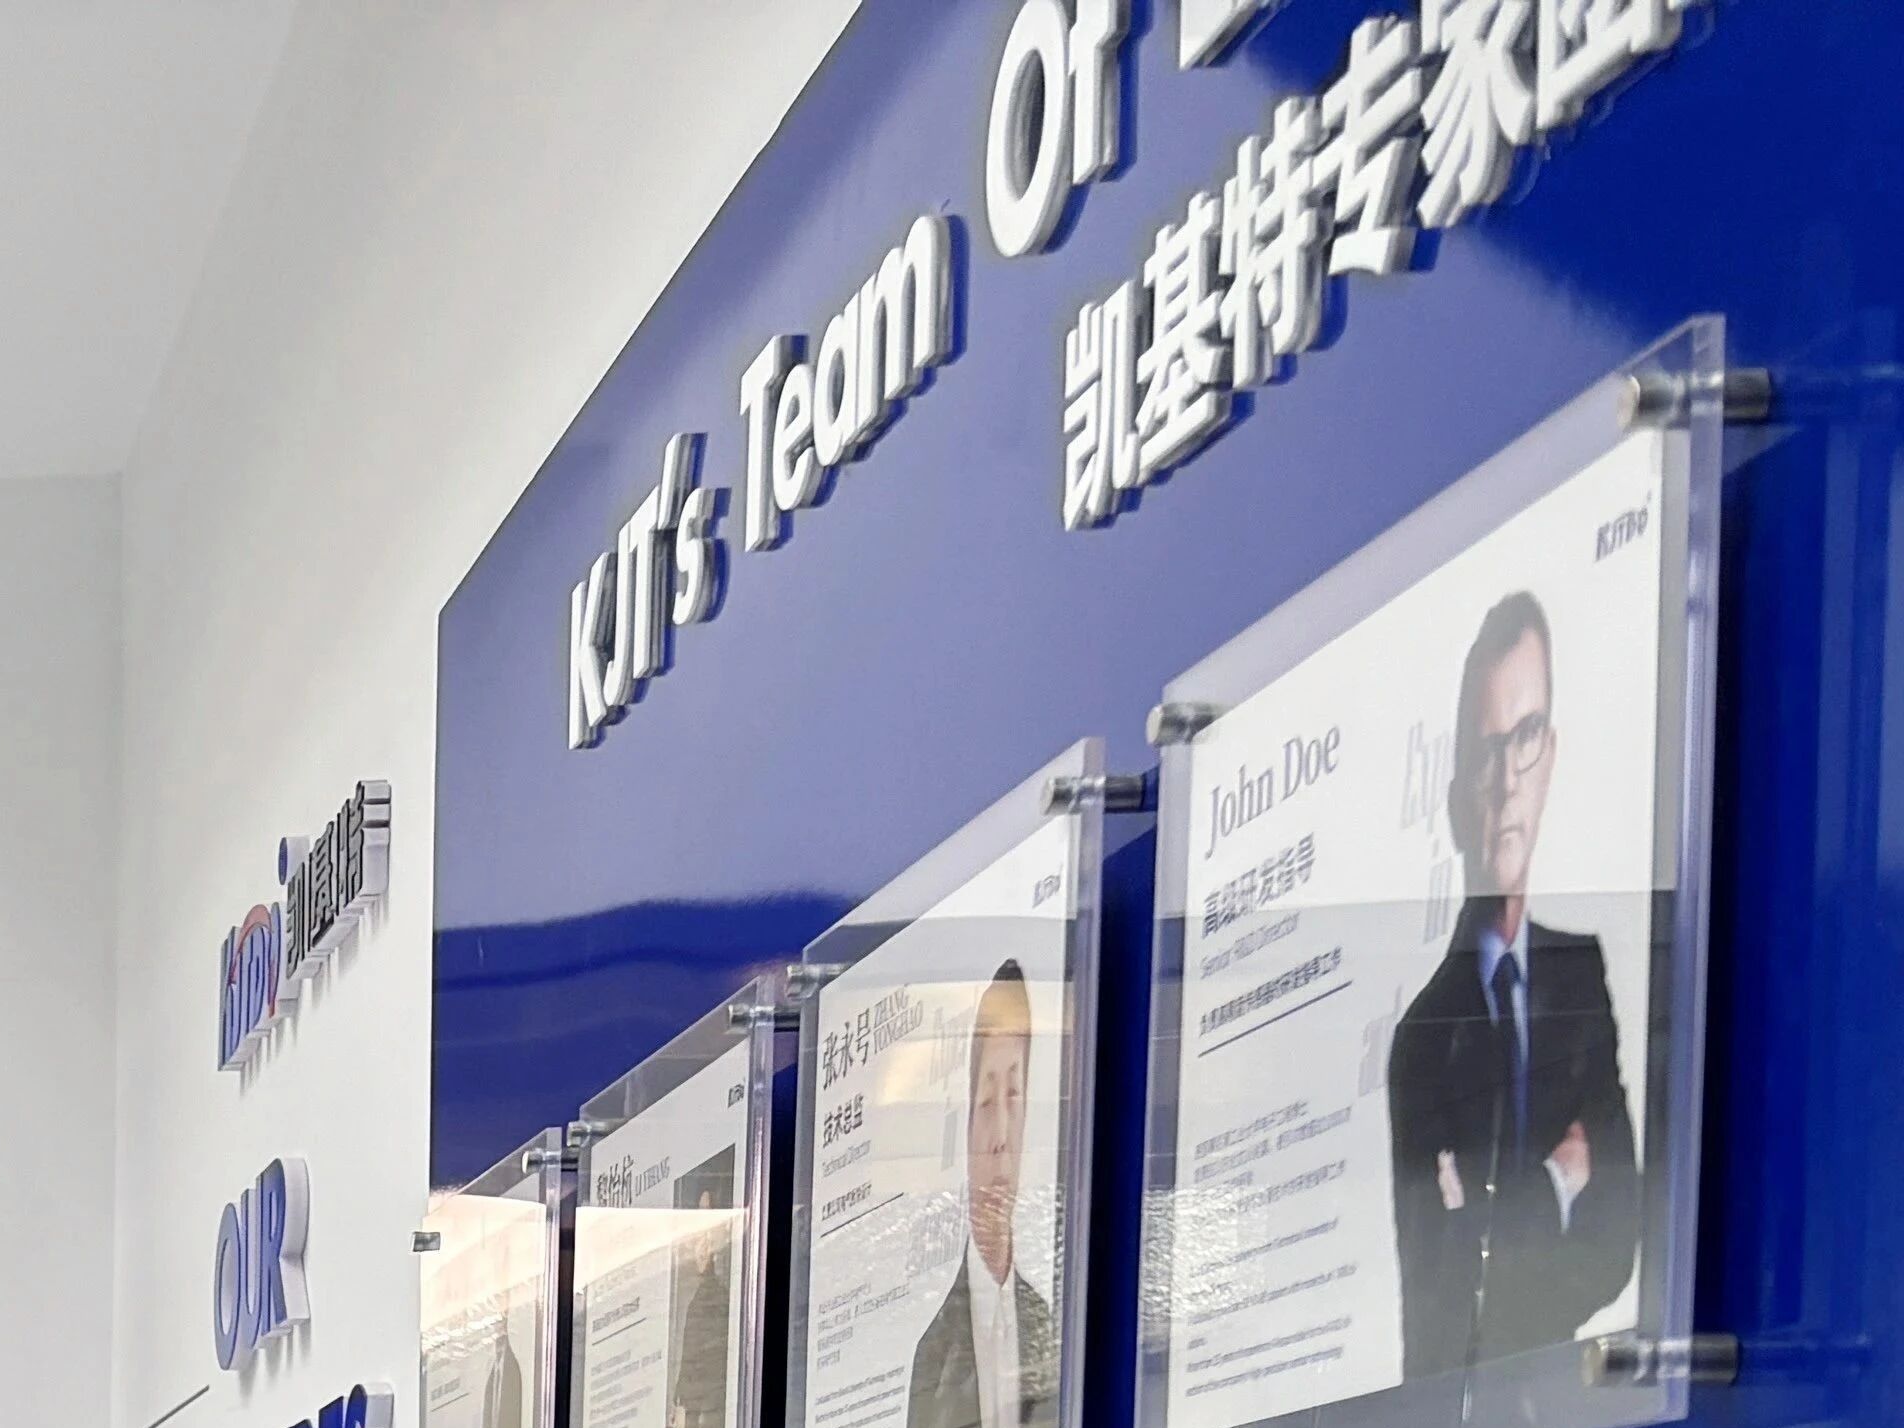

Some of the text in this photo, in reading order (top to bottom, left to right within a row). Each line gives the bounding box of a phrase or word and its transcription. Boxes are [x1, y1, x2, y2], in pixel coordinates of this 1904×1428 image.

[568, 0, 1124, 750] KJT's Team Of
[1204, 726, 1341, 860] John Doe
[213, 1157, 288, 1371] OUR
